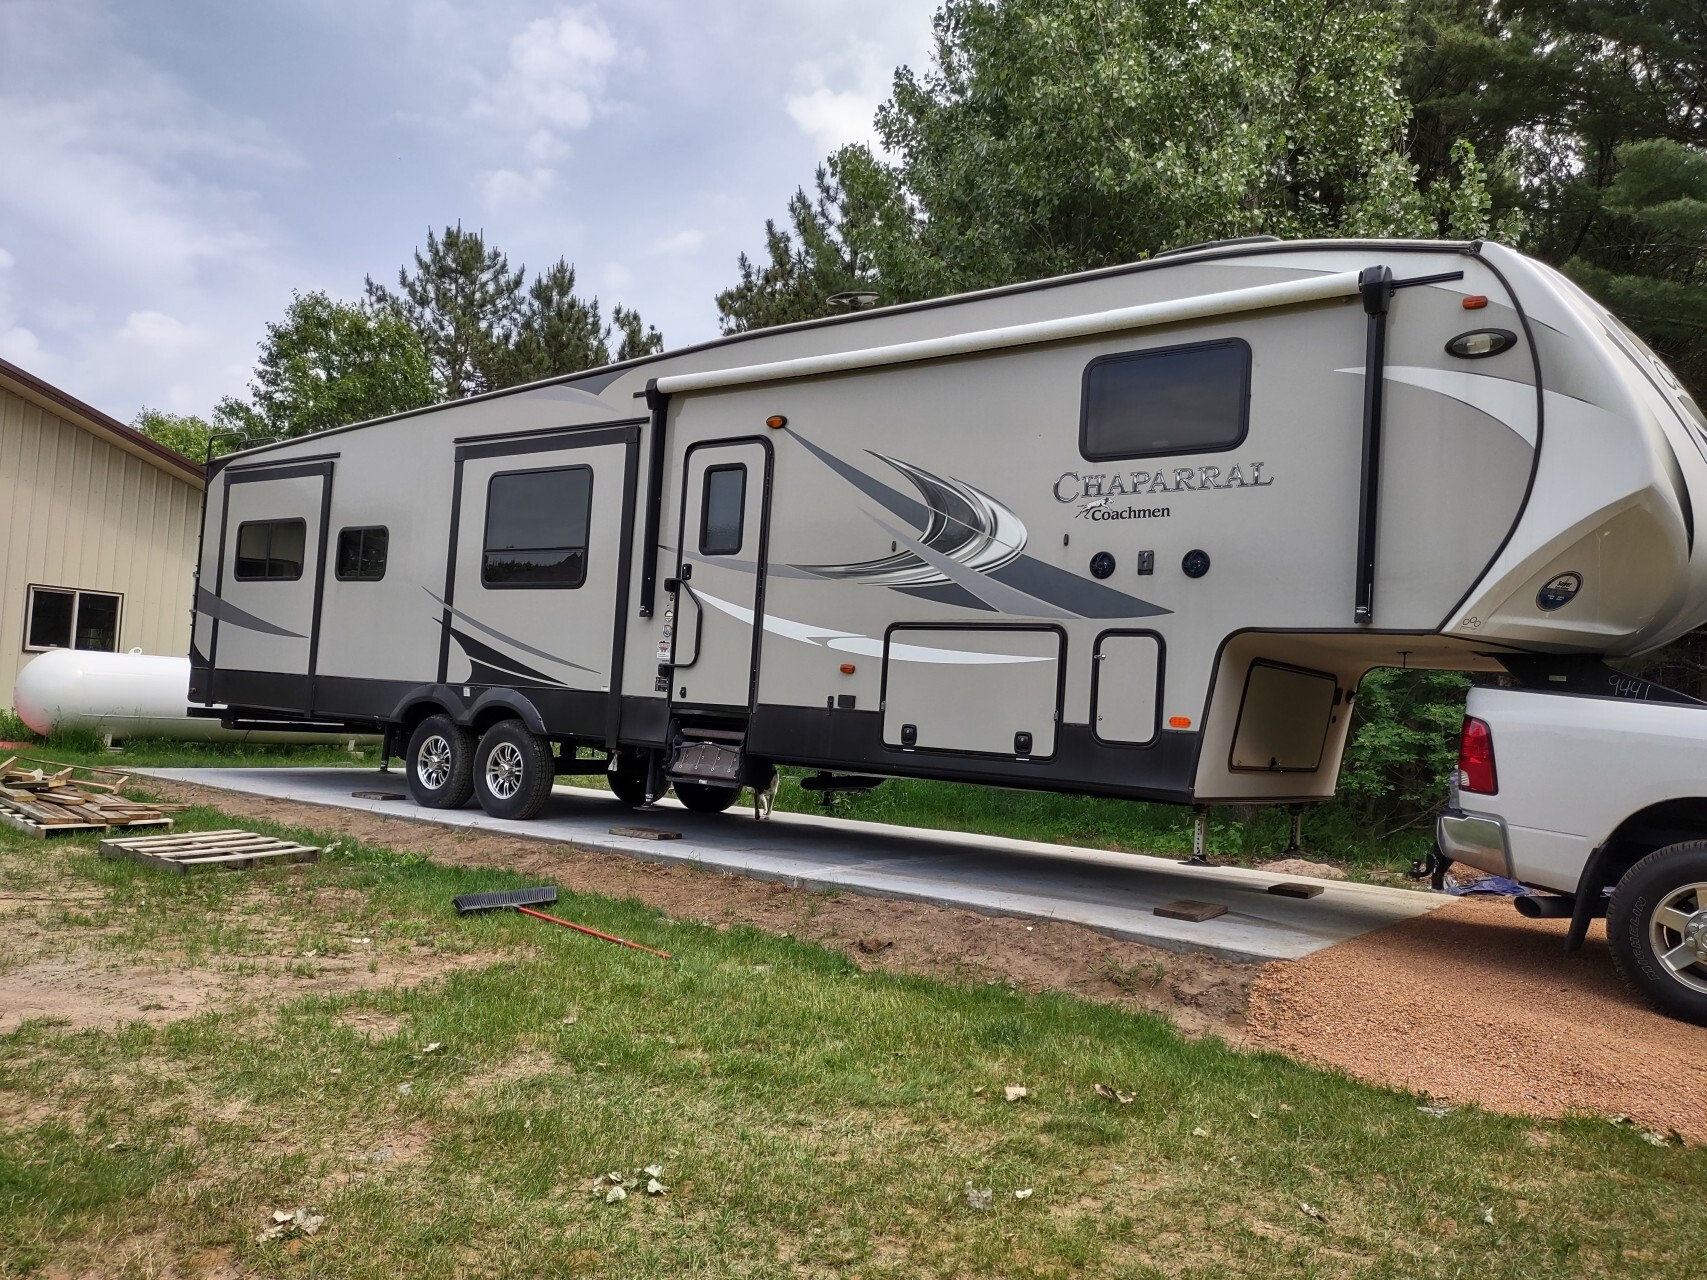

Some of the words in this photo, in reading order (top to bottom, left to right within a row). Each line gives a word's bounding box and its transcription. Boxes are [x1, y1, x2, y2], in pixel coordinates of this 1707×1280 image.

[1053, 461, 1274, 504] CHAPARRAL
[1091, 506, 1171, 522] Coachmen
[1608, 674, 1651, 700] 9441
[1629, 895, 1660, 980] MICHELIN
